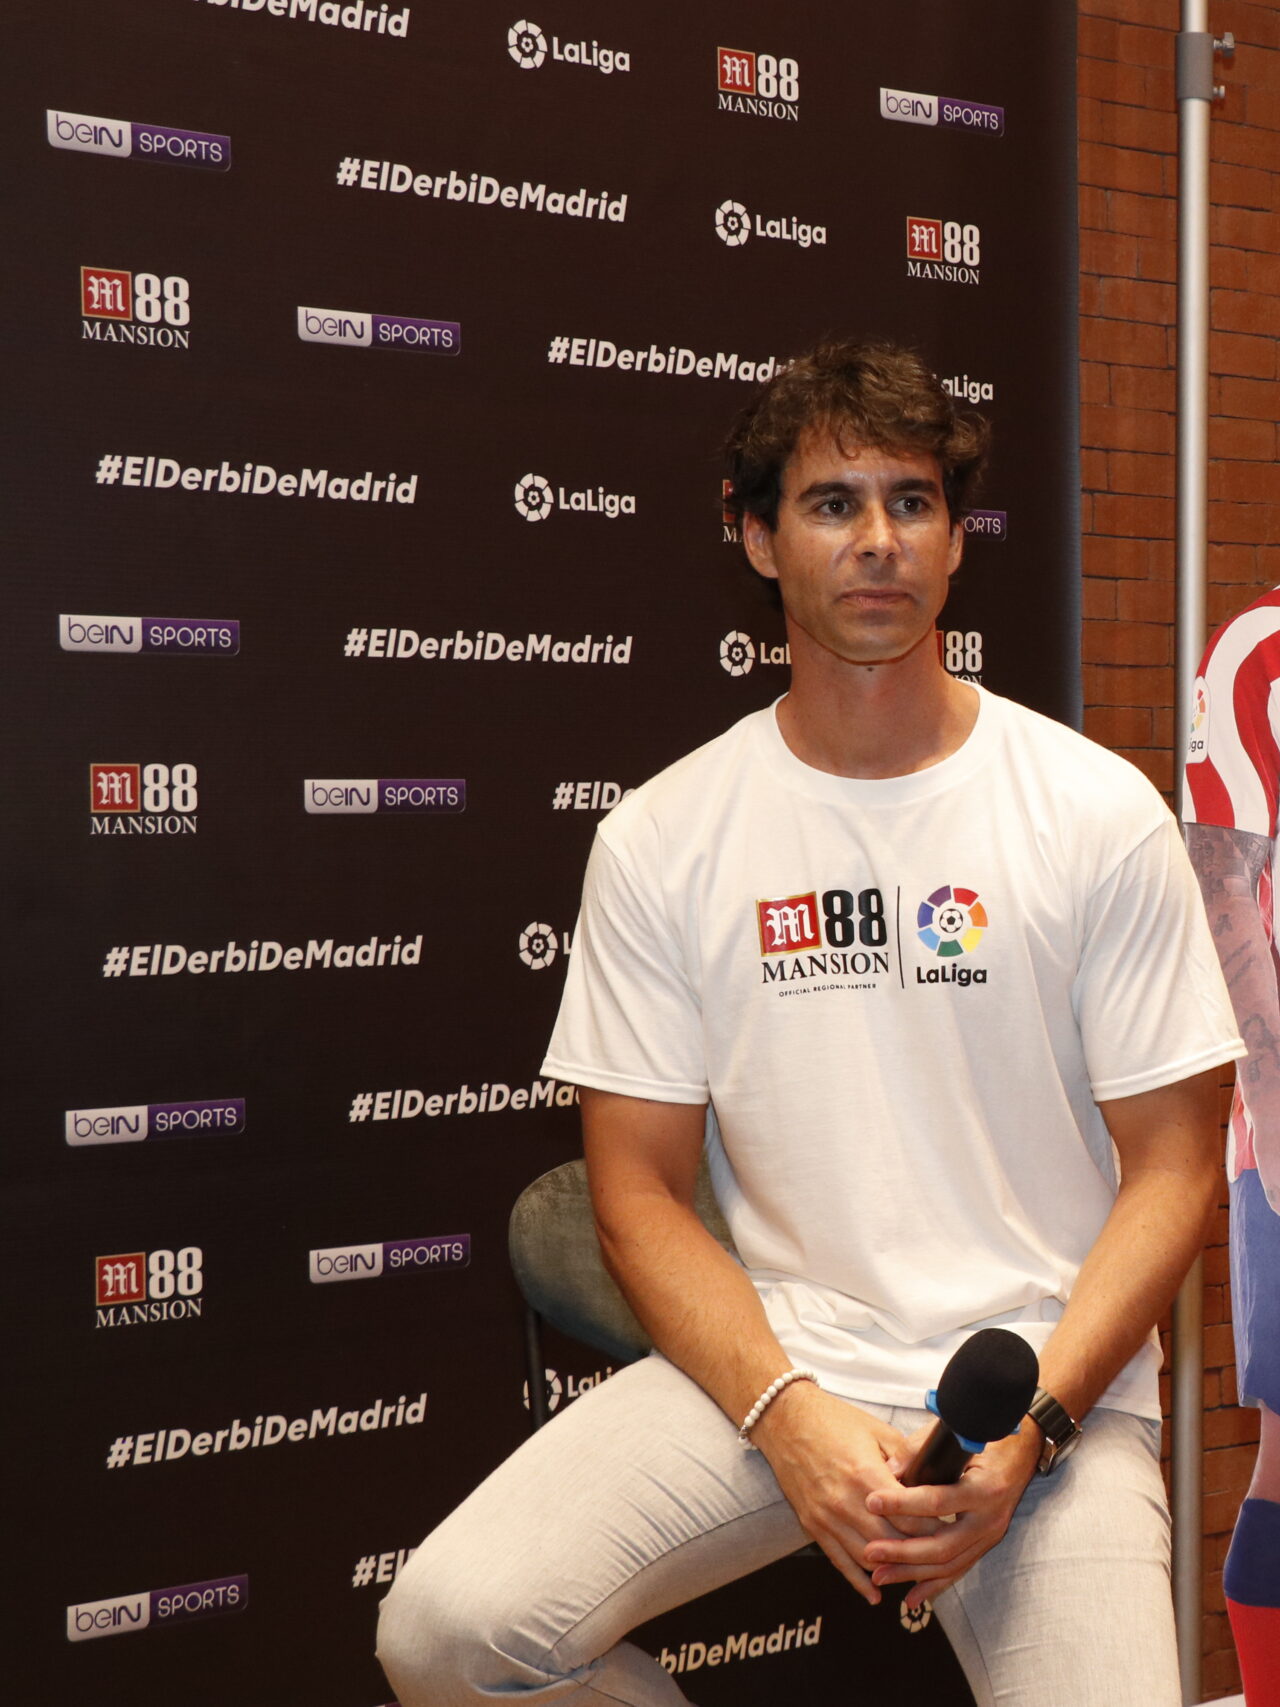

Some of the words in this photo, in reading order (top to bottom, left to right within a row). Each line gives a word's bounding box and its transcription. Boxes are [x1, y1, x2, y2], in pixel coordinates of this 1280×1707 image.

[552, 36, 630, 74] LaLiga
[718, 94, 799, 121] MANSION
[943, 106, 999, 130] SPORTS
[139, 132, 223, 163] SPORTS
[336, 157, 628, 222] #ElDerbiDeMadrid
[755, 214, 827, 248] LaLiga
[907, 262, 980, 285] MANSION
[82, 320, 190, 349] MANSION
[379, 322, 453, 348] SPORTS
[548, 336, 796, 383] #ElDerbiDeMad
[932, 373, 993, 404] aLiga
[96, 454, 418, 504] #ElDerbiDeMadrid
[559, 487, 636, 518] LaLiga
[963, 515, 1001, 534] ORTS
[150, 625, 232, 648] SPORTS
[344, 628, 633, 664] #ElDerbiDeMadrid
[1189, 739, 1204, 753] ga
[385, 786, 458, 806] SPORTS
[91, 815, 197, 835] MANSION
[103, 934, 423, 978] #ElDerbiDeMadrid
[761, 952, 889, 983] MANSION
[778, 988, 811, 997] OFFICIAL
[813, 984, 846, 992] REGIONAL
[917, 963, 988, 987] LaLiga
[349, 1080, 580, 1123] #ElDerbiDeMa
[156, 1107, 237, 1131] SPORTS
[390, 1242, 463, 1268] SPORTS
[96, 1299, 202, 1329] MANSION
[107, 1393, 427, 1469] #ElDerbiDeMadrid
[352, 1548, 417, 1588] #El
[158, 1584, 239, 1616] SPORTS
[656, 1616, 822, 1675] biDeMadrid
